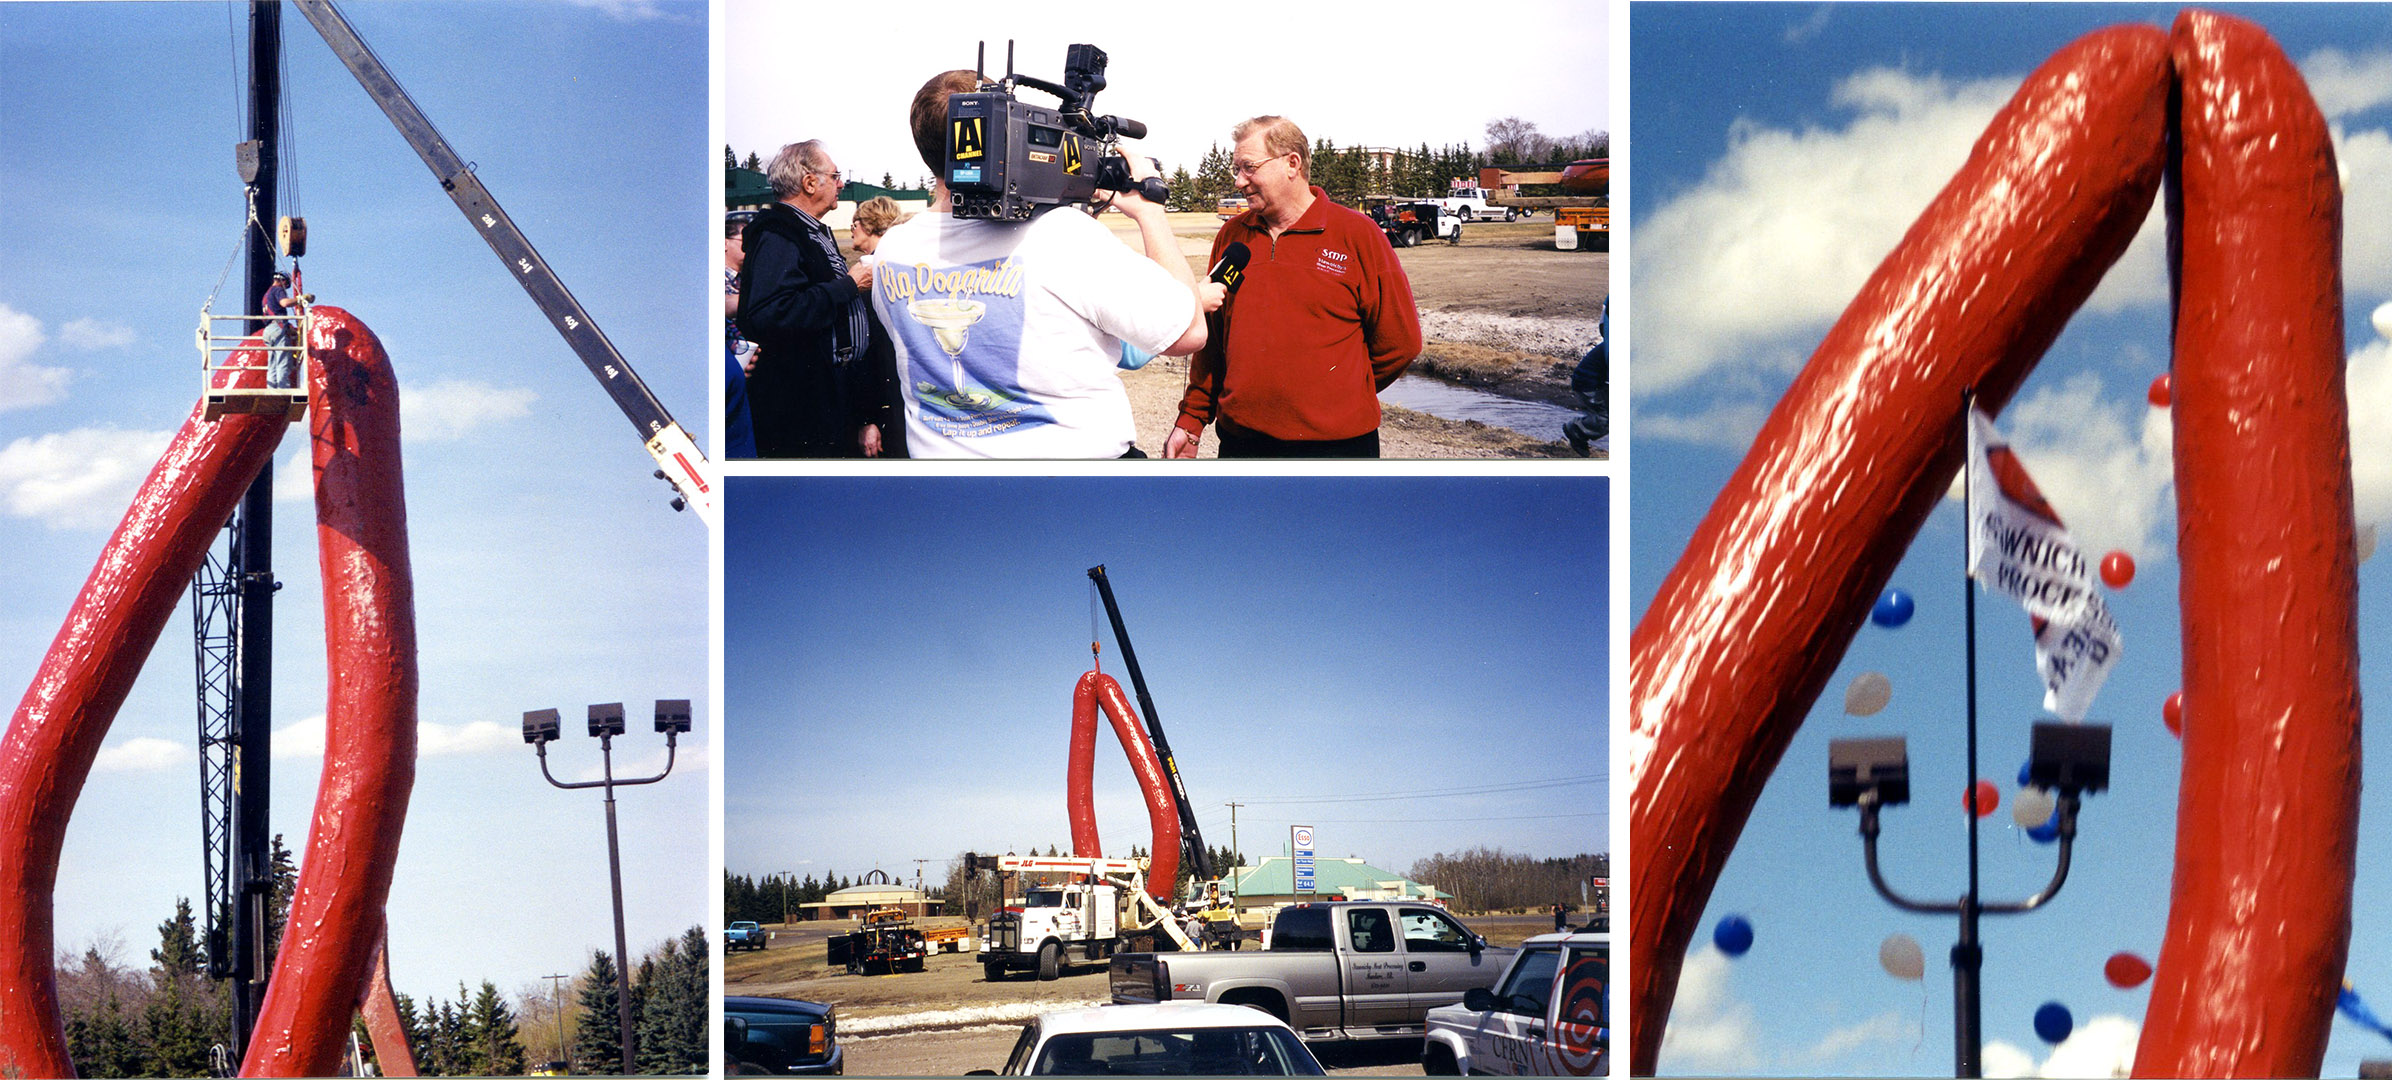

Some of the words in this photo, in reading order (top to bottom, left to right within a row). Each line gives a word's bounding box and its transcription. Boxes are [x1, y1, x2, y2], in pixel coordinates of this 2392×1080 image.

[957, 150, 983, 160] CHANNEL
[518, 258, 531, 271] 34
[879, 260, 915, 303] Big
[914, 260, 1022, 301] Dogarita
[564, 315, 576, 327] 40
[604, 364, 616, 377] 46
[942, 428, 957, 437] Lap
[958, 428, 965, 436] it
[967, 430, 977, 438] up
[978, 425, 992, 435] and
[1298, 833, 1310, 841] Esso
[1492, 1035, 1528, 1065] CFRN
